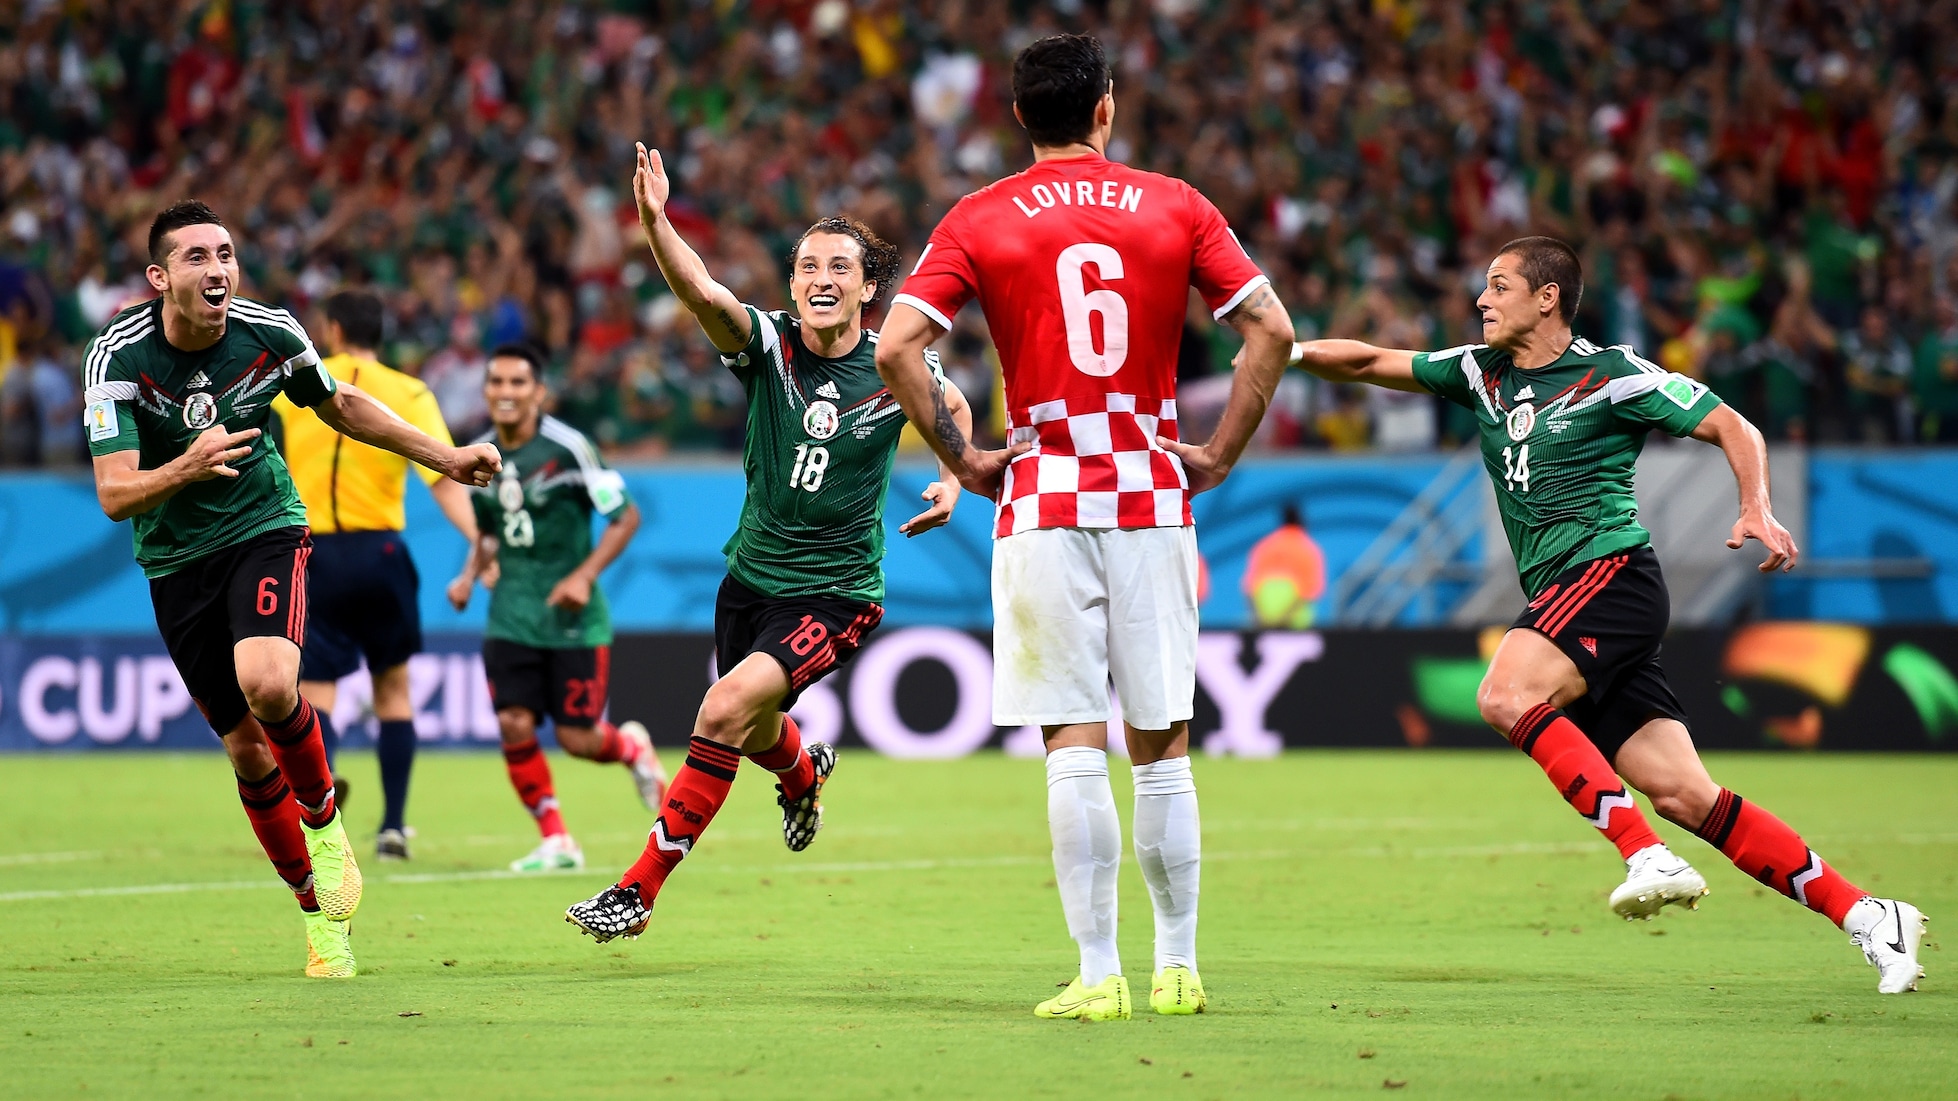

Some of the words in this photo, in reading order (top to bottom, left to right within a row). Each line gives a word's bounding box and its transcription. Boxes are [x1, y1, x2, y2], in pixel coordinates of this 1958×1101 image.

[1012, 181, 1143, 218] LOVREN
[1056, 242, 1129, 377] 6
[789, 443, 830, 492] 18
[1502, 444, 1530, 492] 14
[503, 509, 535, 547] 23
[257, 576, 279, 616] 6
[780, 614, 828, 657] 18
[19, 655, 193, 744] CUP
